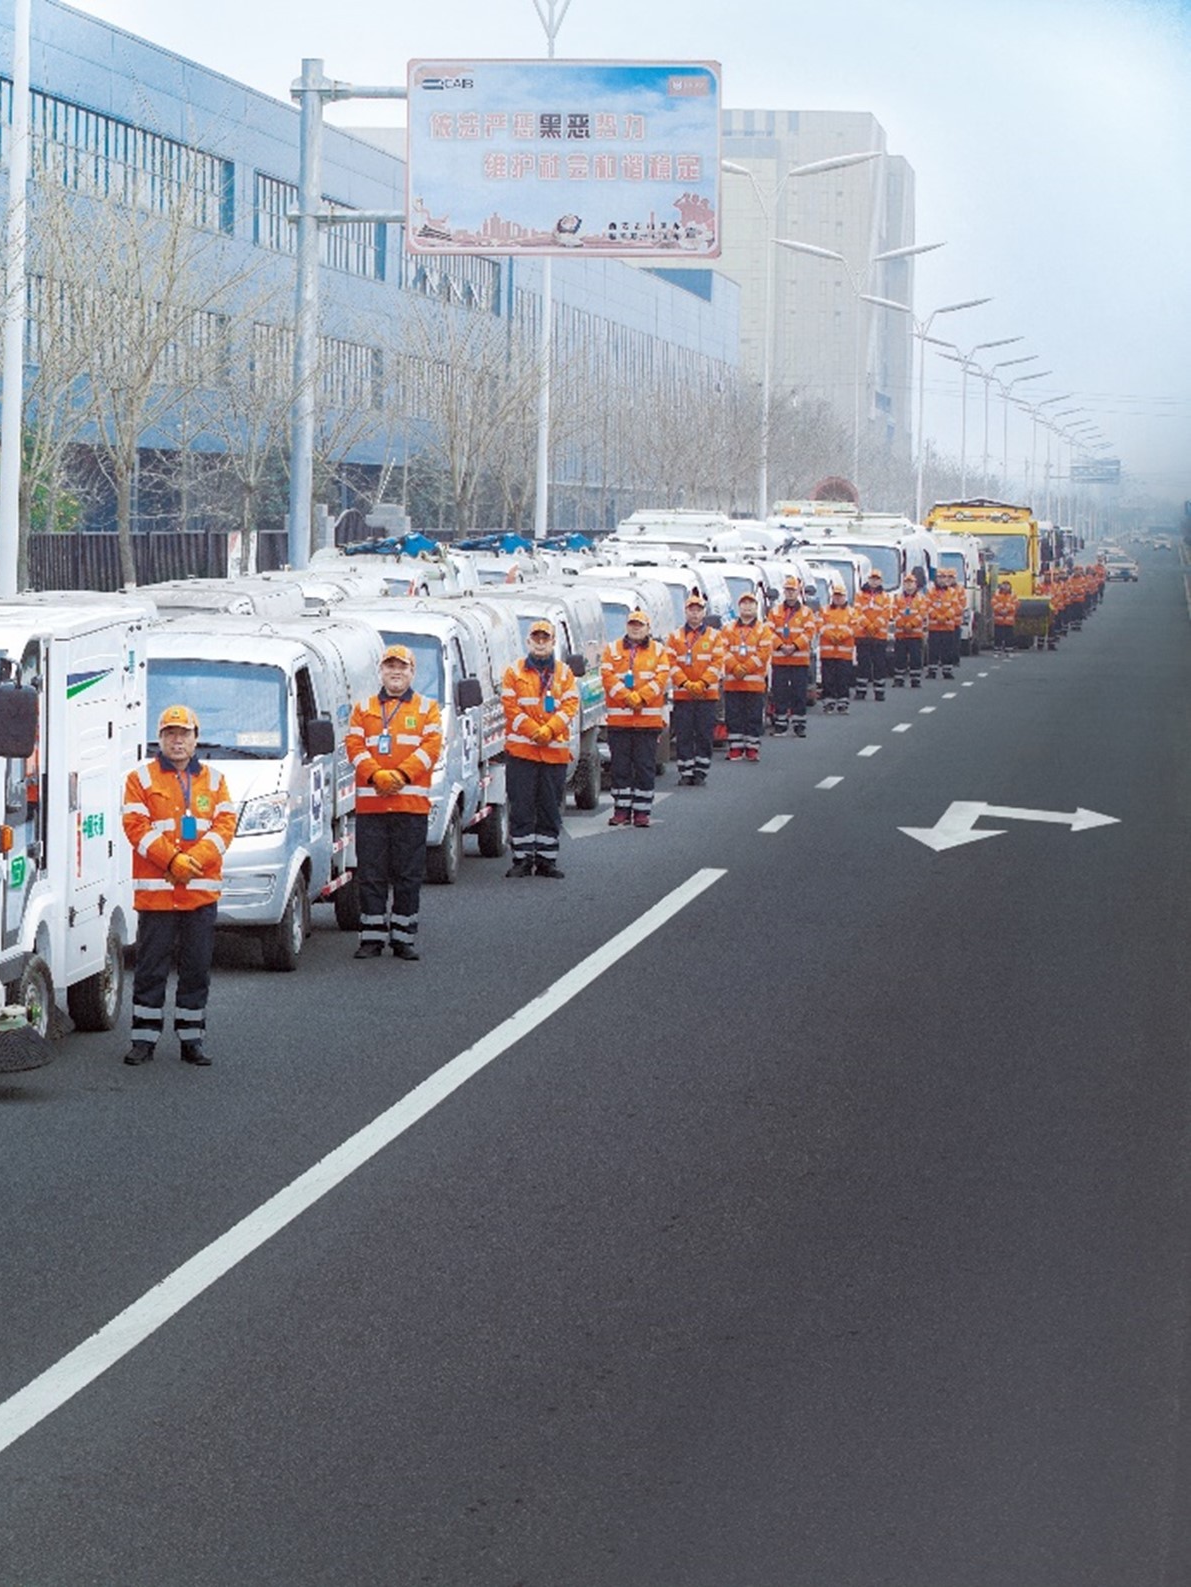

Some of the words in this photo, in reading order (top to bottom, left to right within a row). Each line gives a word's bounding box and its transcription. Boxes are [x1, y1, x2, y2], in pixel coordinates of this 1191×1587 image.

[429, 111, 646, 140] 依法严惩黑恶势力
[483, 153, 703, 182] 维护社会和谐稳定
